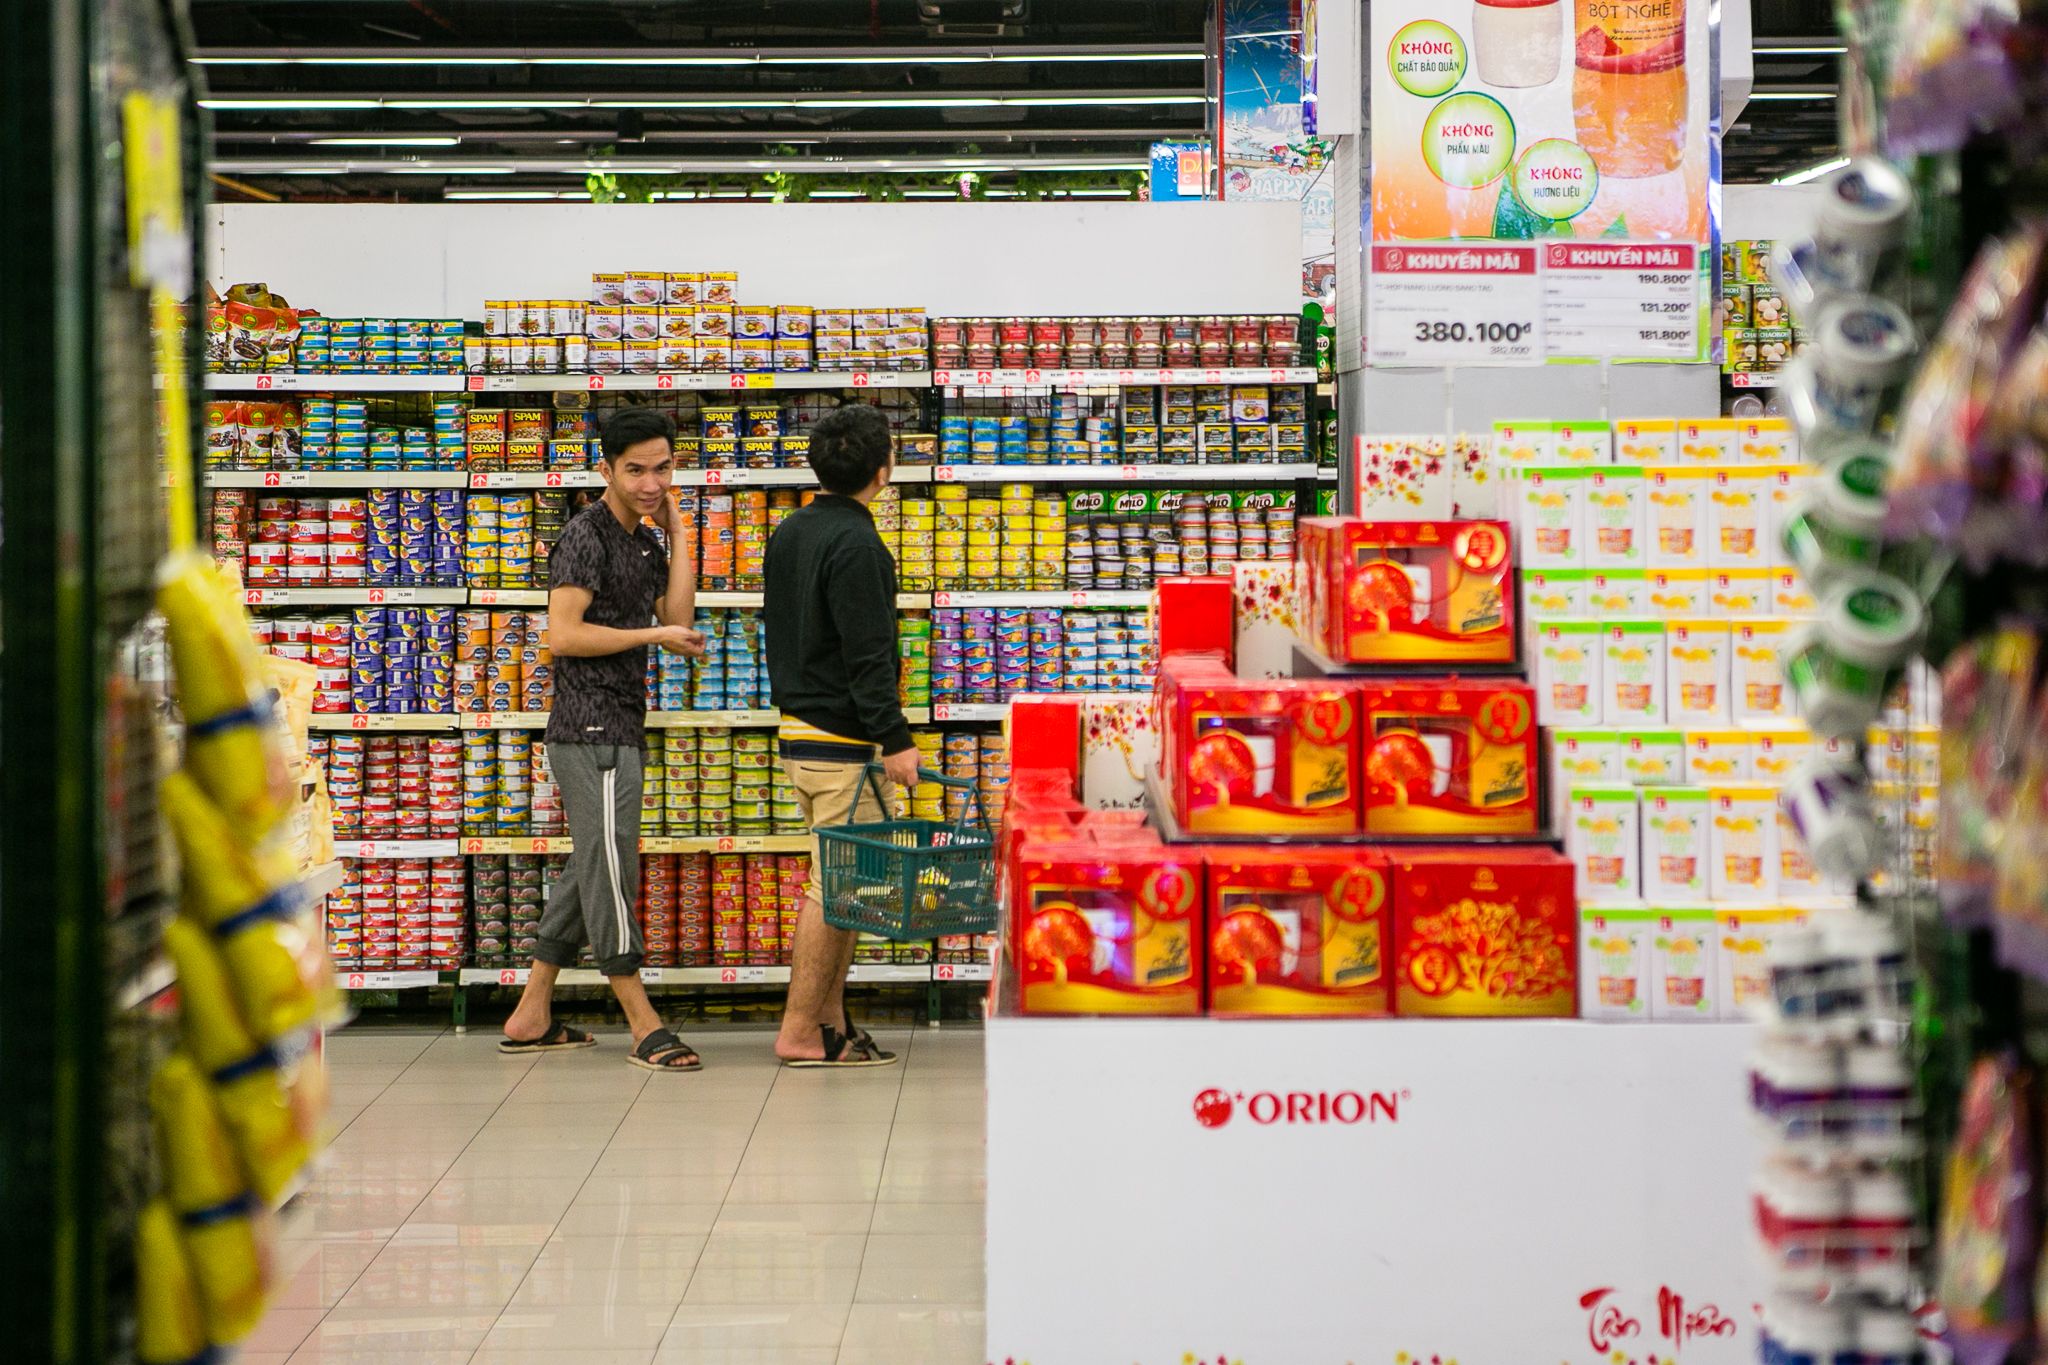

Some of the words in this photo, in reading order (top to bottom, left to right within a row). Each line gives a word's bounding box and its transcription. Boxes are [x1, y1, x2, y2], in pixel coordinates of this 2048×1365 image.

[1401, 40, 1453, 55] KHÔNG
[1442, 123, 1494, 137] KHÔNG
[1530, 165, 1583, 179] KHÔNG
[1251, 178, 1309, 195] HAPPY
[1407, 250, 1483, 270] KHUYẾN
[1487, 252, 1520, 270] MÃI
[1571, 246, 1643, 265] KHUYẾN
[1645, 249, 1679, 265] MÃI
[470, 414, 498, 423] SPAM
[514, 412, 541, 421] SPAM
[556, 414, 583, 422] SPAM
[706, 413, 733, 421] SPAM
[750, 411, 777, 420] SPAM
[472, 444, 500, 453] SPAM
[510, 445, 537, 454] SPAM
[556, 444, 583, 453] SPAM
[706, 443, 734, 452] SPAM
[745, 443, 773, 452] SPAM
[1076, 498, 1101, 508] MILO
[1120, 500, 1144, 509] MILO
[1247, 499, 1271, 508] MILO
[1248, 1090, 1399, 1124] ORION
